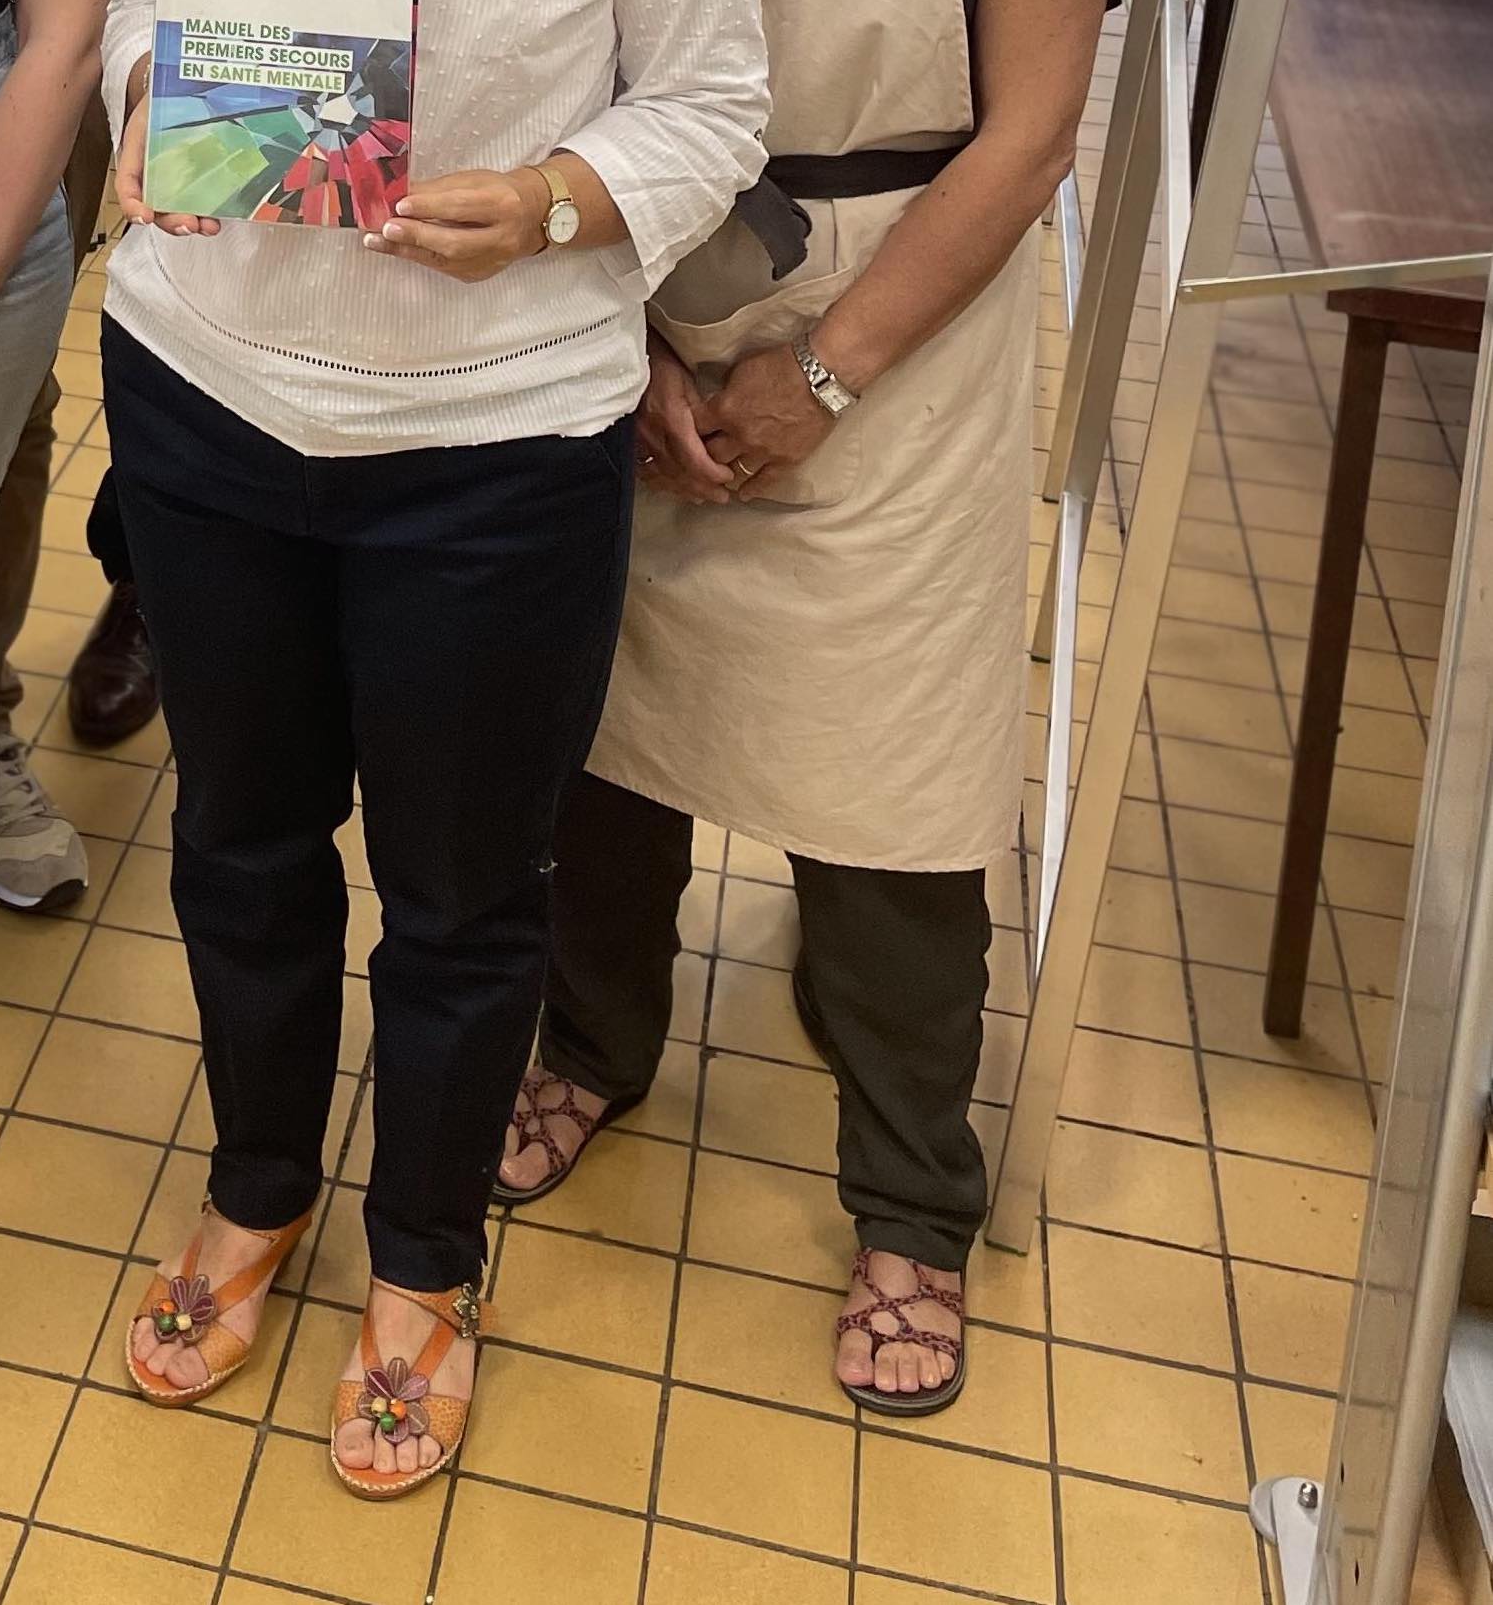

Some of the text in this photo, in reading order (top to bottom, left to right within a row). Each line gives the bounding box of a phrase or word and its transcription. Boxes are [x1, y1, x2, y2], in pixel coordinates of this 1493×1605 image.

[185, 18, 291, 40] MANUEL DES
[184, 40, 350, 69] PREMIERS SECOURS
[182, 63, 342, 91] EN SANTÉ MENTALE
